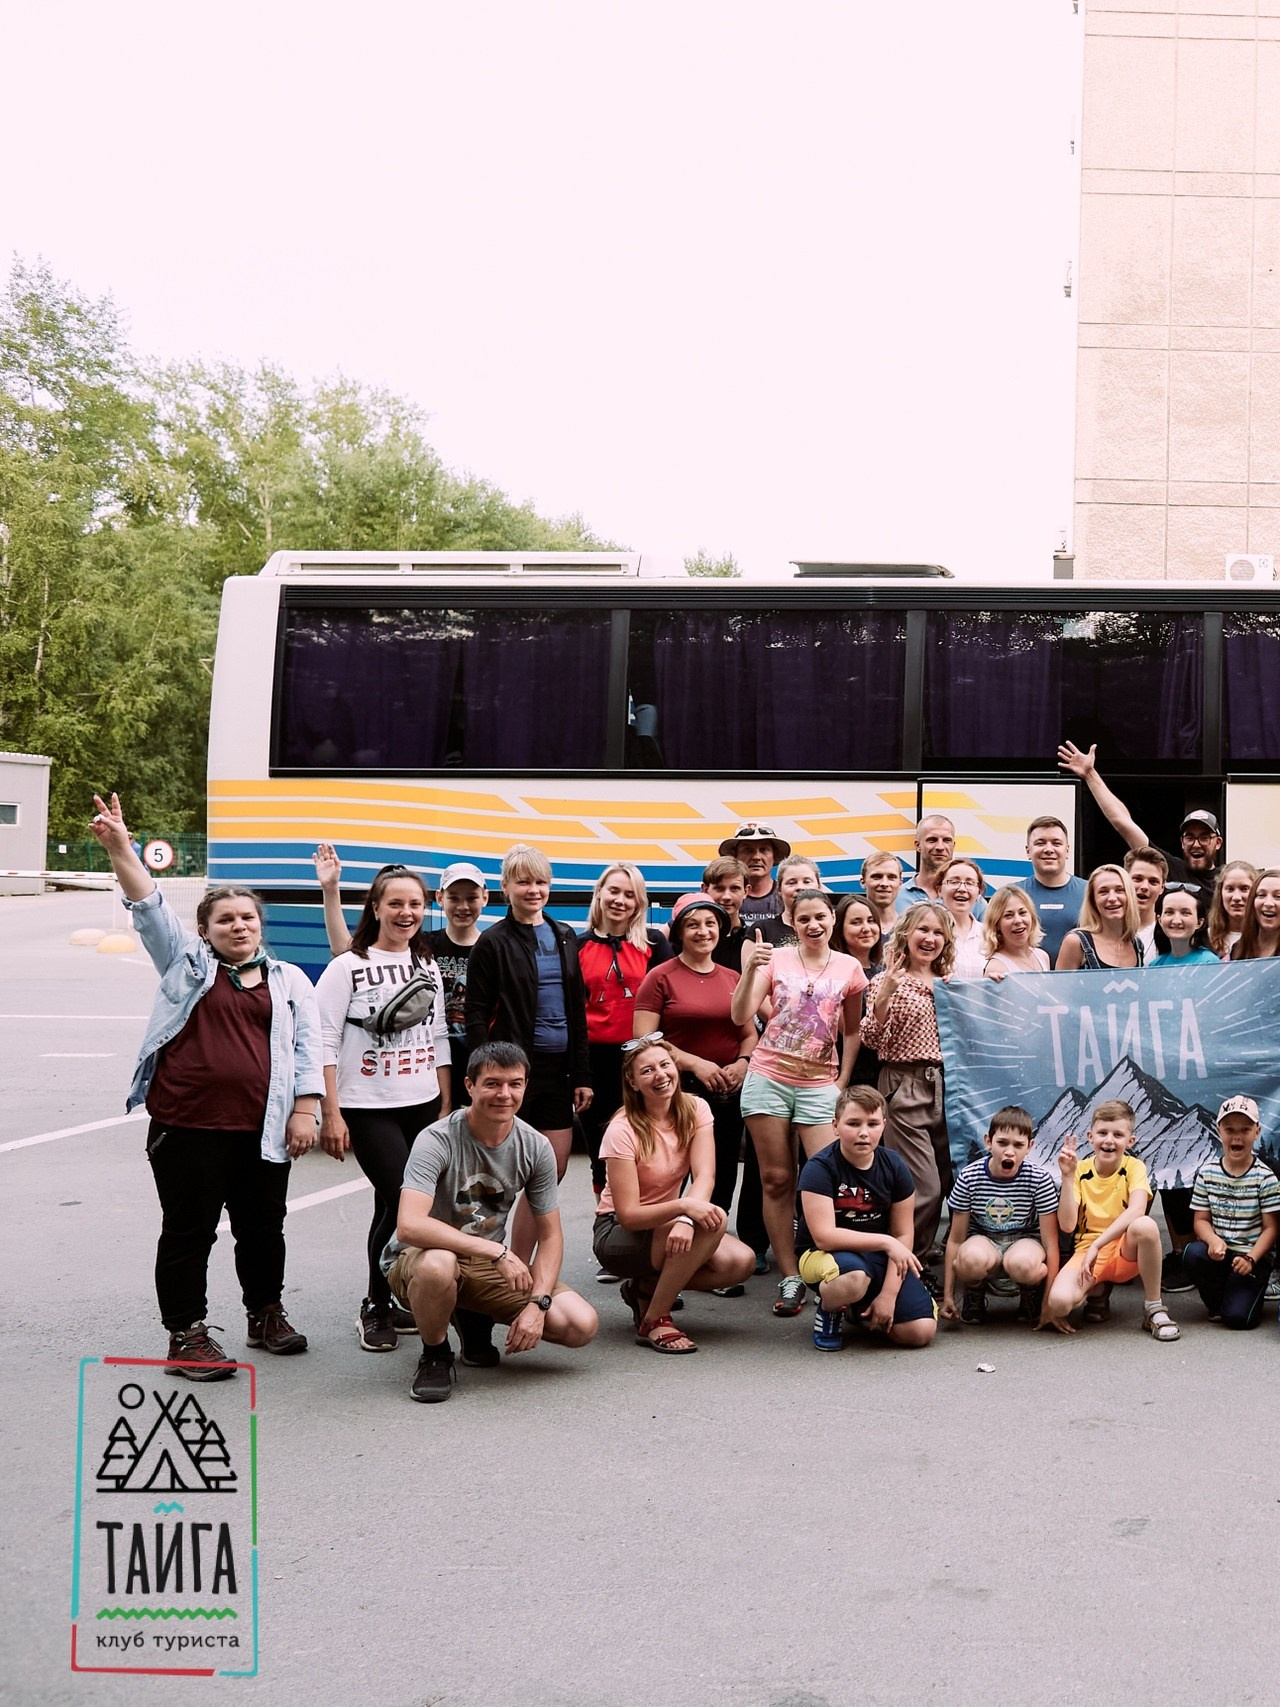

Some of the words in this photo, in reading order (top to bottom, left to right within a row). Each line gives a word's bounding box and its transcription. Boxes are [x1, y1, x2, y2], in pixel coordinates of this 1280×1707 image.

[154, 848, 164, 862] 5
[351, 964, 437, 993] FUTUE
[1036, 977, 1209, 1088] ТАЙГА
[360, 1045, 435, 1077] STEPS
